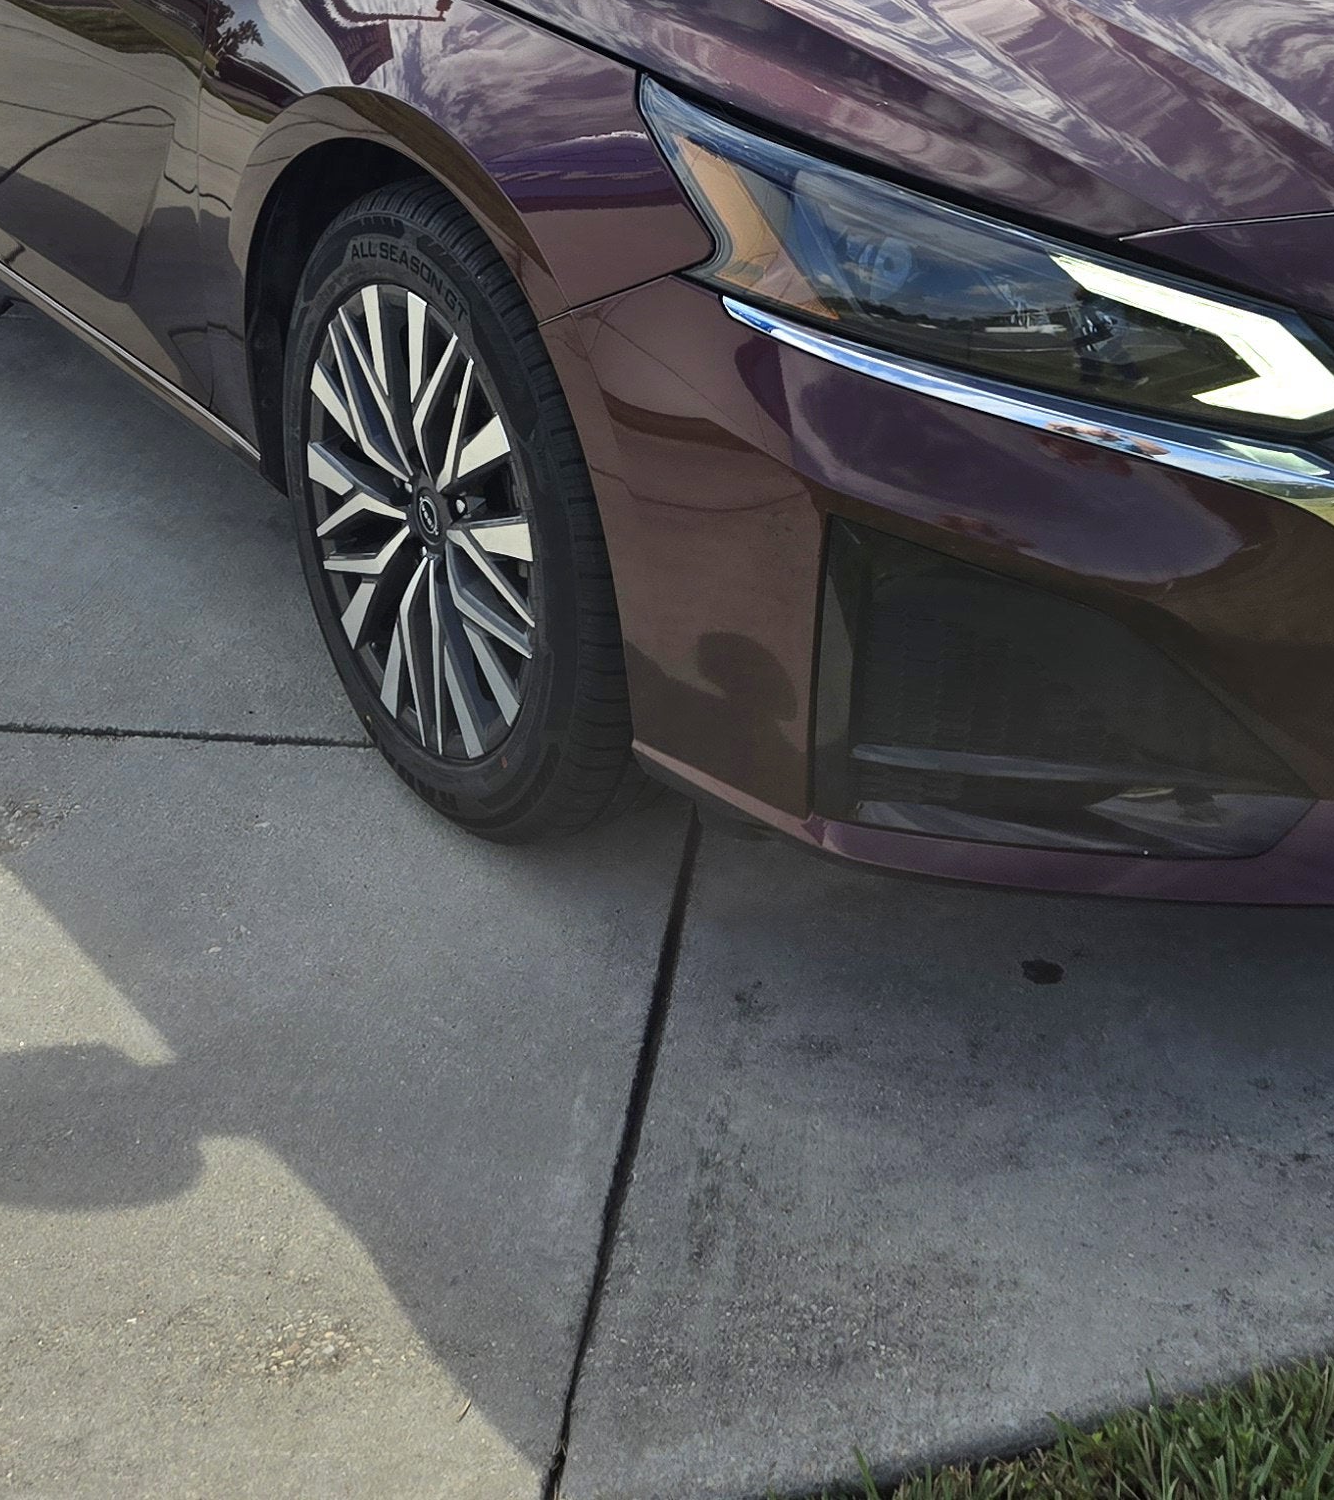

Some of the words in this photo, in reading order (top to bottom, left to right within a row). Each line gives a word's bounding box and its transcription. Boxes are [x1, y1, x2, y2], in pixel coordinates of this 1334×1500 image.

[351, 241, 377, 261] ALL
[379, 242, 443, 295] SEASON
[444, 288, 467, 322] GT
